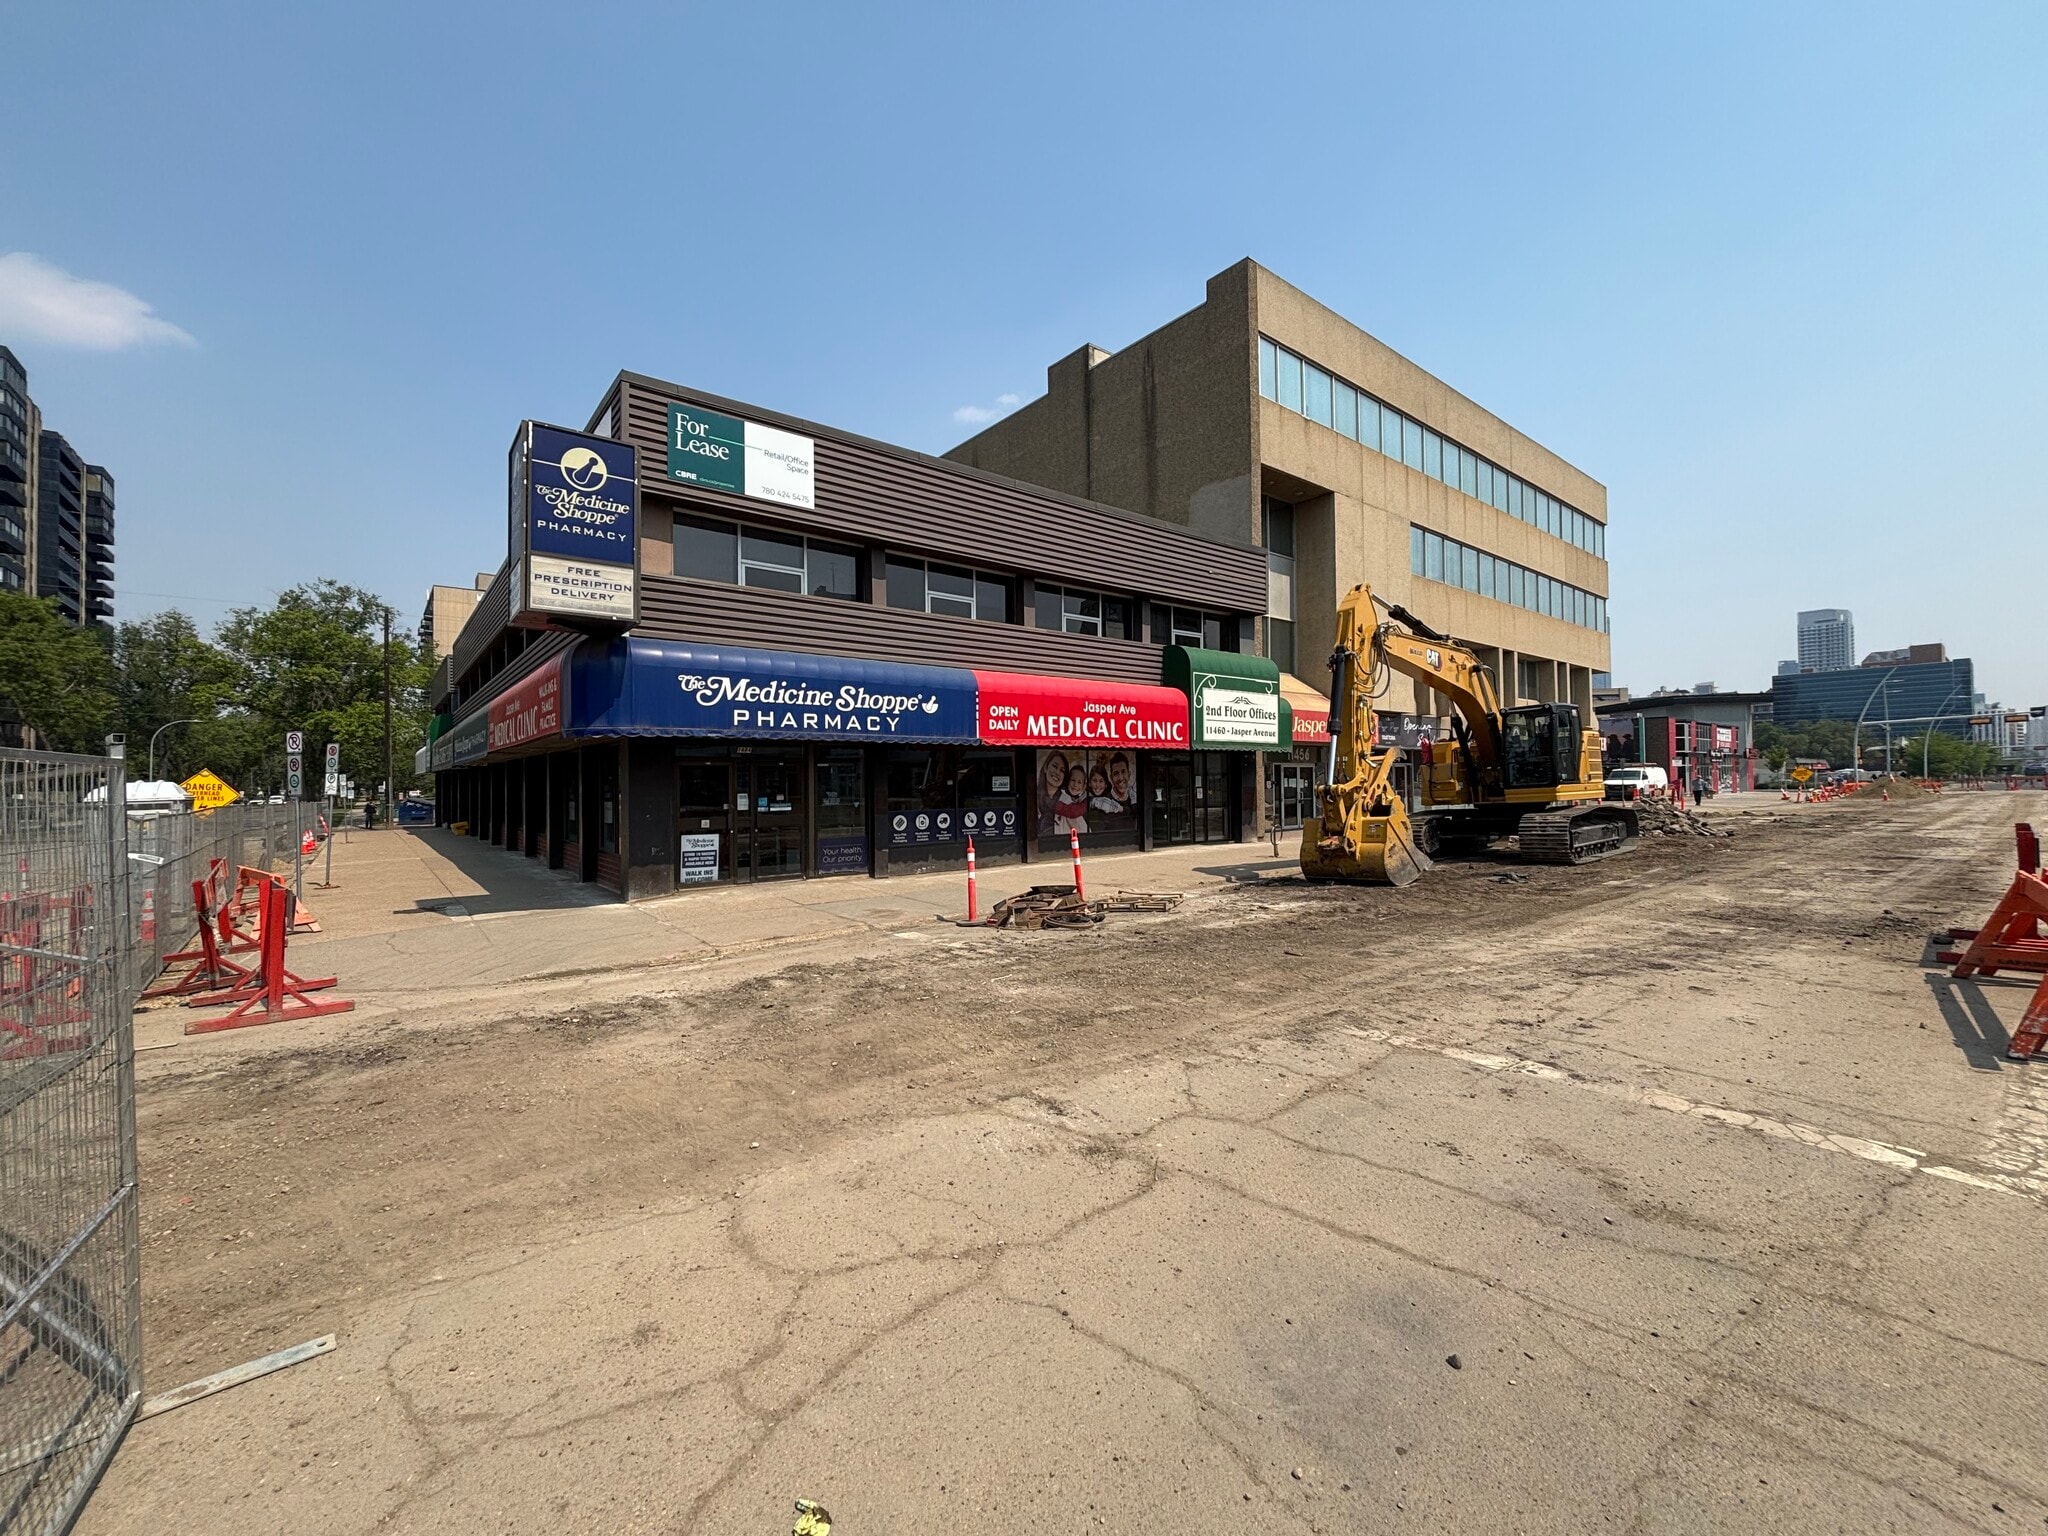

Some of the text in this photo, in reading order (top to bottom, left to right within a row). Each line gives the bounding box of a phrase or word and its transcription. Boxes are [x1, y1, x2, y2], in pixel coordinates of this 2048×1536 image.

[675, 412, 709, 438] For
[675, 431, 730, 460] Lease
[764, 449, 809, 467] Retail/Office
[675, 470, 697, 480] CBRE
[786, 463, 809, 475] Space
[545, 487, 630, 514] Medicine
[761, 486, 810, 503] 780 424 5475
[553, 502, 616, 525] Shoppe
[537, 520, 626, 542] PHARMACY
[567, 567, 601, 577] FREE
[534, 574, 632, 592] PRESCRIPTION
[551, 588, 615, 601] DELIVERY
[1426, 648, 1440, 668] CAT
[678, 674, 919, 714] The Medicine Shoppe
[989, 705, 1019, 717] OPEN
[1083, 701, 1136, 715] Jasper Ave
[1205, 705, 1276, 720] 2nd Floor Offices
[494, 717, 516, 746] MEDICAL
[516, 705, 538, 740] CLINIC
[733, 709, 899, 732] PHARMACY
[989, 719, 1020, 731] DAILY
[1027, 715, 1184, 741] MEDICAL CLINIC
[1292, 716, 1328, 737] Jaspe
[1206, 726, 1226, 735] 11460
[1231, 727, 1252, 737] Jasper
[1253, 728, 1276, 737] Avenue
[186, 783, 223, 791] DANGER
